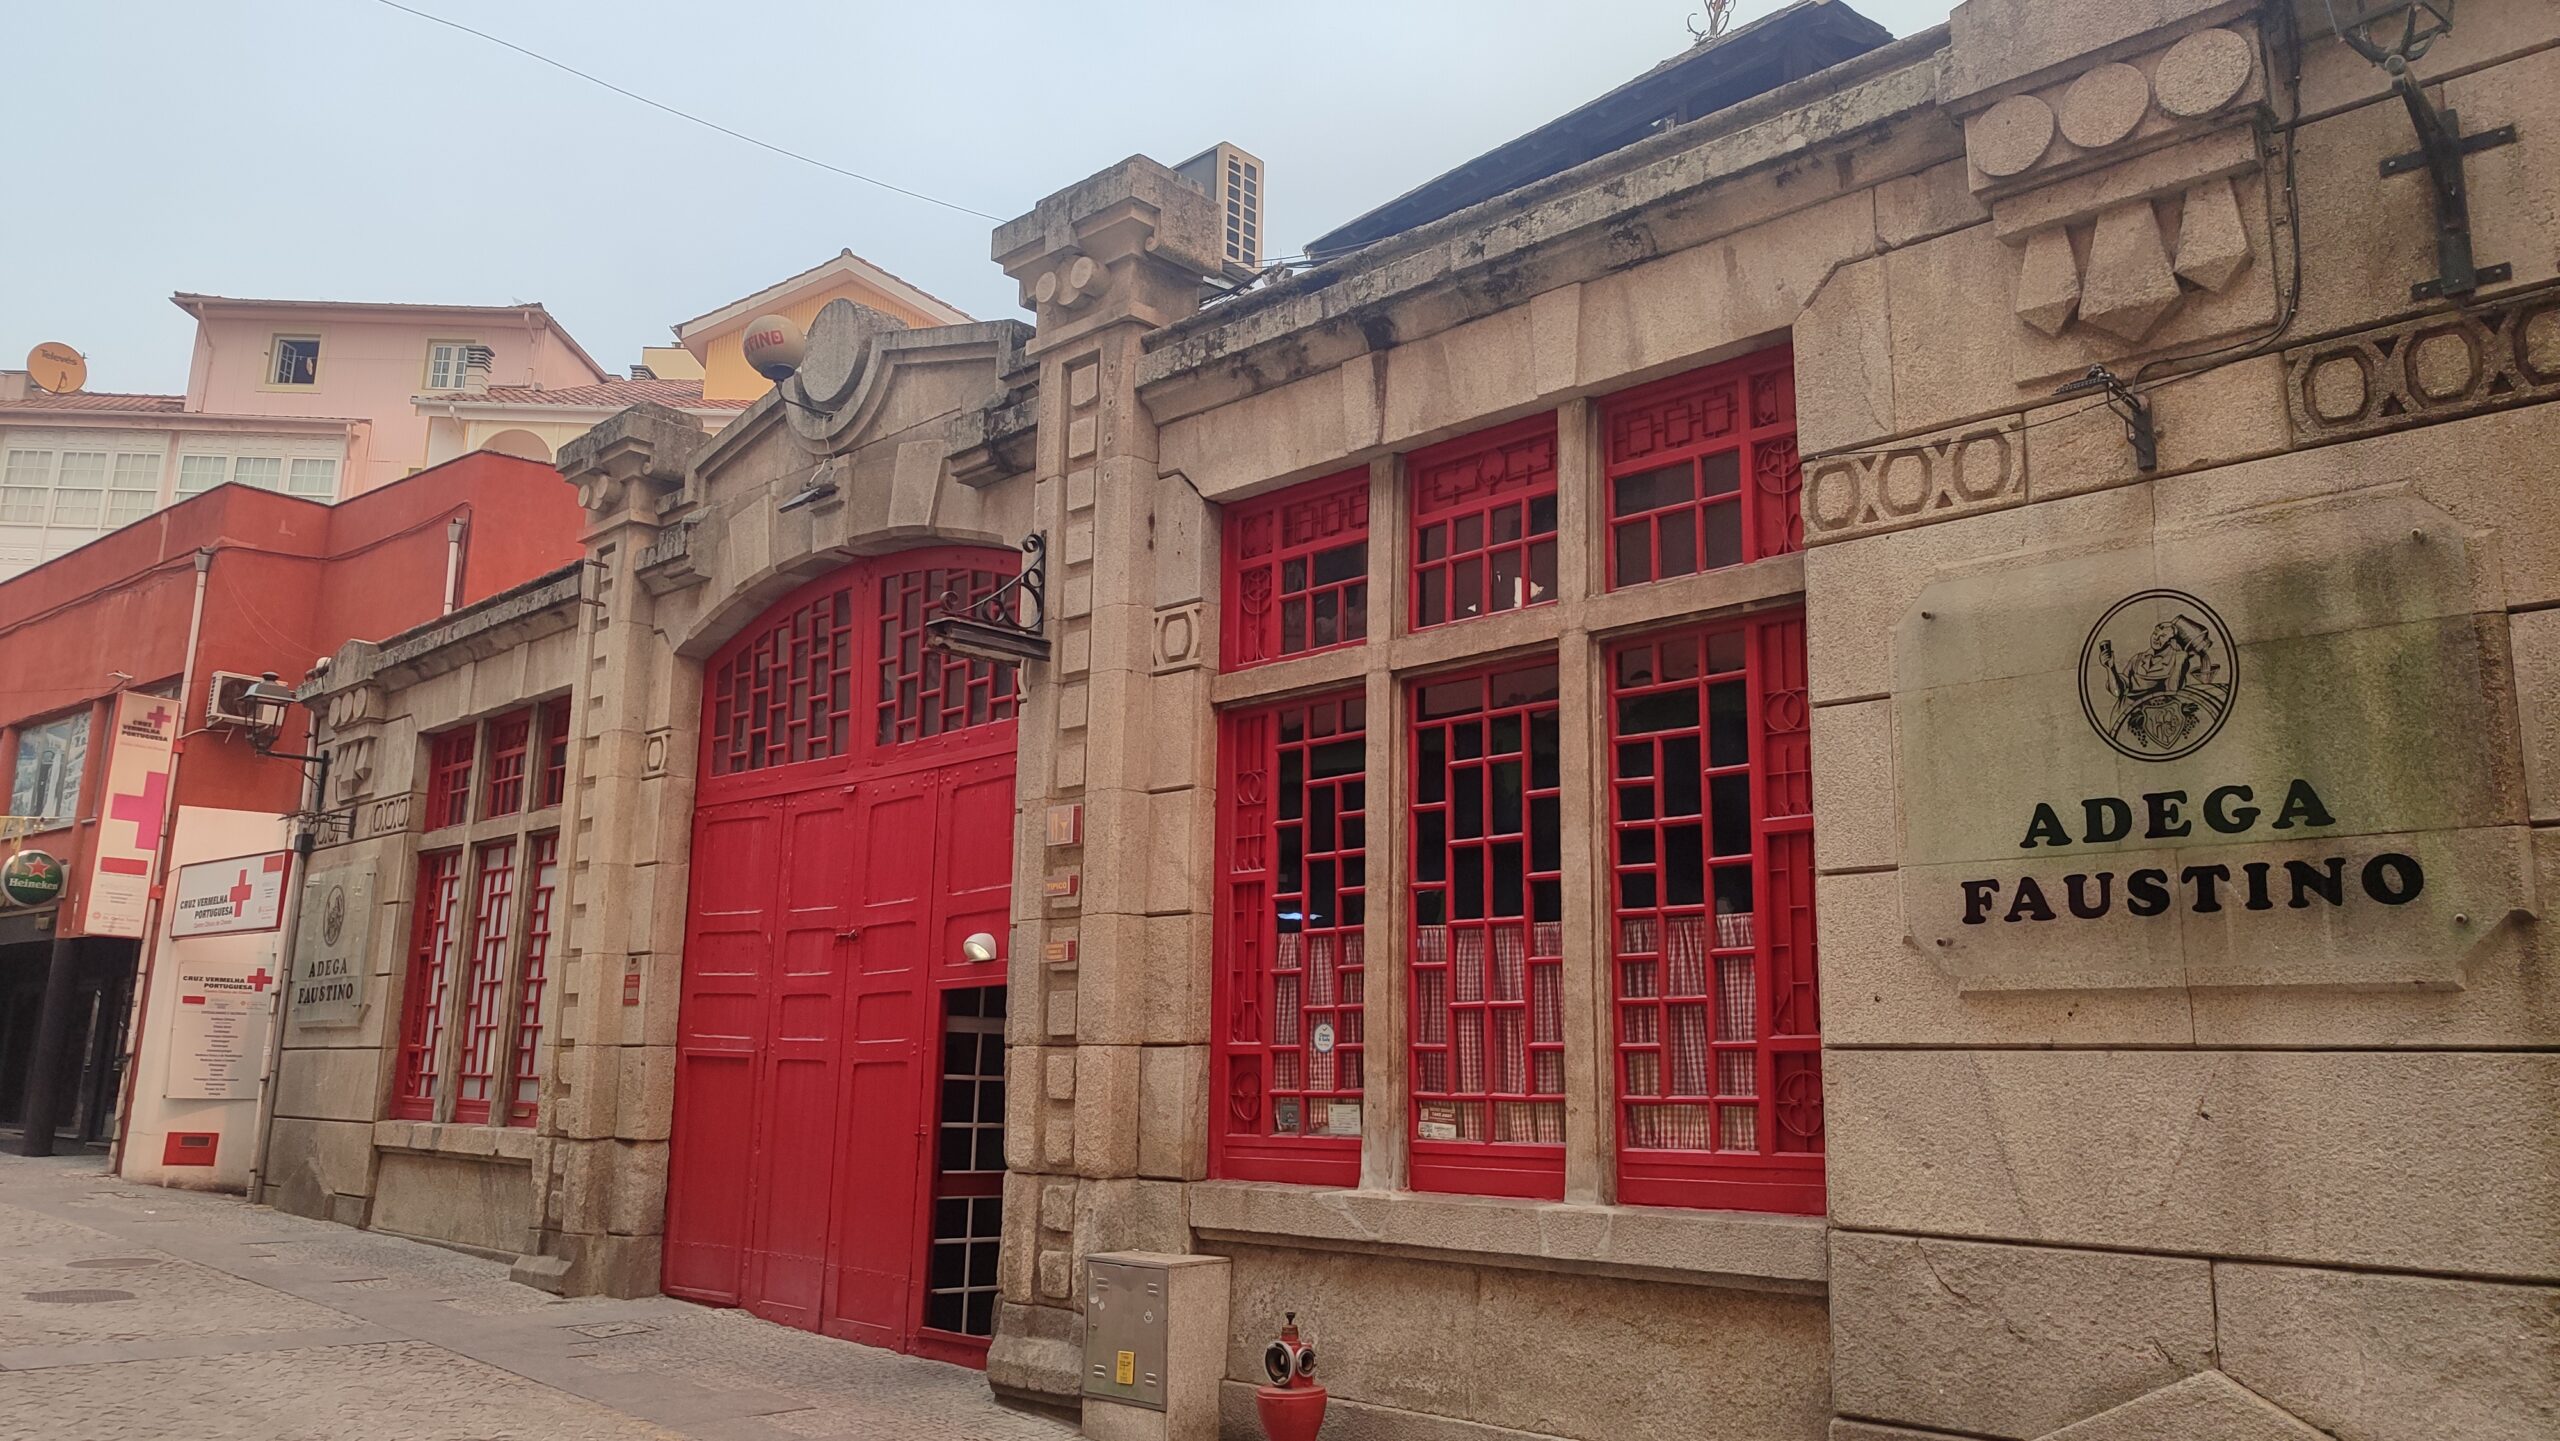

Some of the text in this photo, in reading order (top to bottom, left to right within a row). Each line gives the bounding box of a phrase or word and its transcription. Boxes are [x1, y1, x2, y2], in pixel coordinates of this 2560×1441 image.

[2019, 779, 2336, 849] ADEGA
[8, 877, 58, 890] Heineken
[1960, 852, 2425, 925] FAUSTINO
[180, 895, 228, 909] CRUZ VERMELHA
[194, 906, 233, 919] PORTUGUESA
[308, 958, 347, 978] ADEGA
[203, 983, 254, 991] PORTUGUESA
[205, 976, 245, 984] VERMELHA
[297, 983, 353, 1004] FAUSTINO
